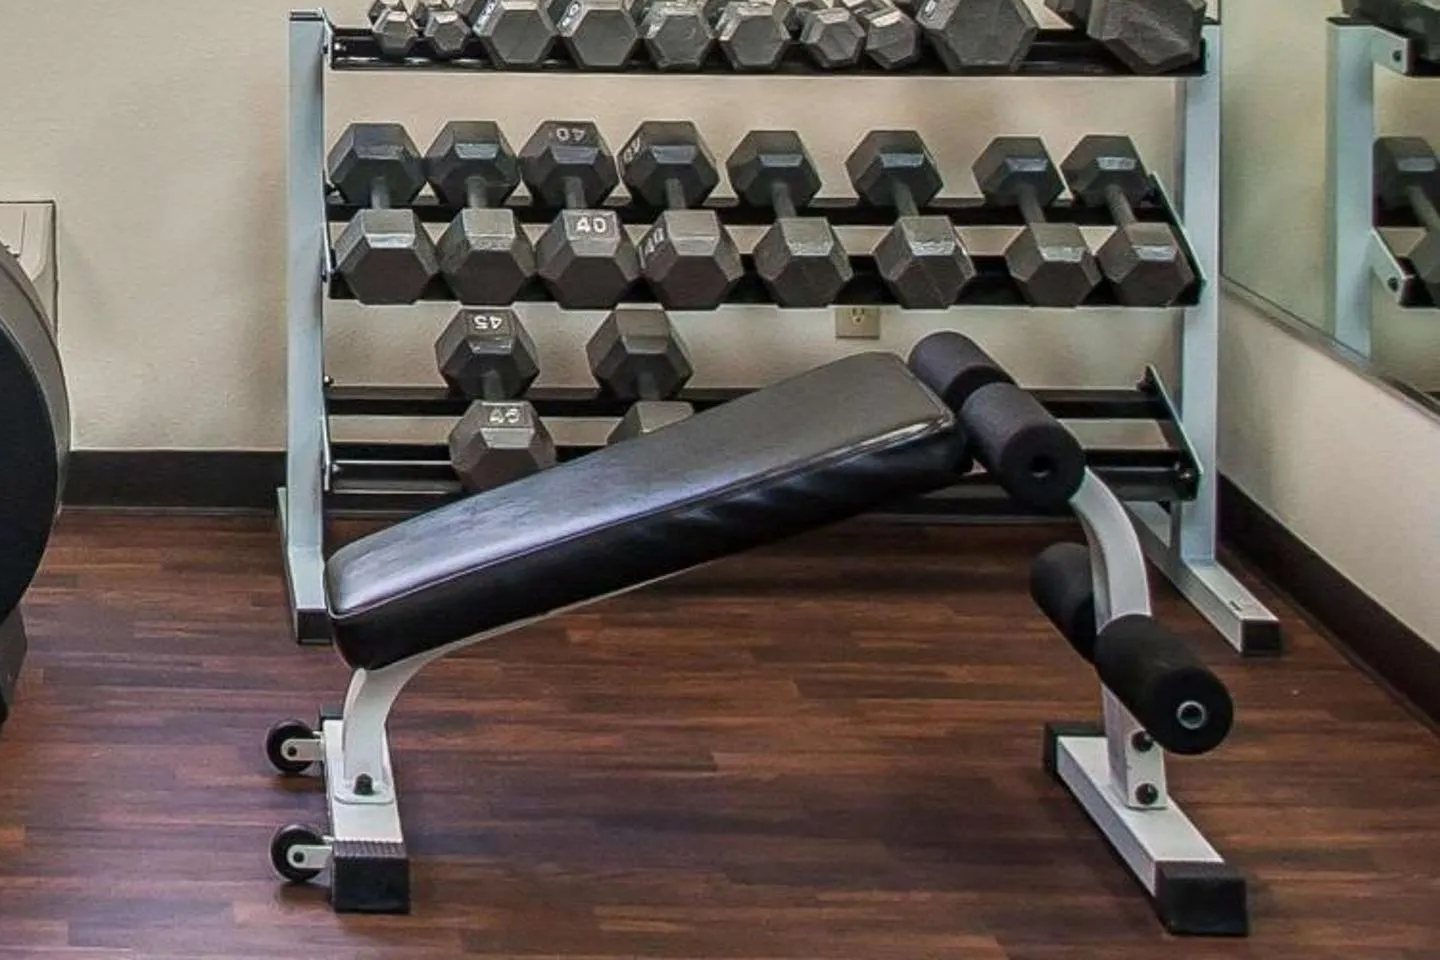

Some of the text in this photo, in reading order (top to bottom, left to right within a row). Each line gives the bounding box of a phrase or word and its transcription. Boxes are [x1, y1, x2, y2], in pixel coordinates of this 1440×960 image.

[556, 128, 586, 141] 40
[575, 217, 607, 232] 40
[473, 314, 503, 330] 45
